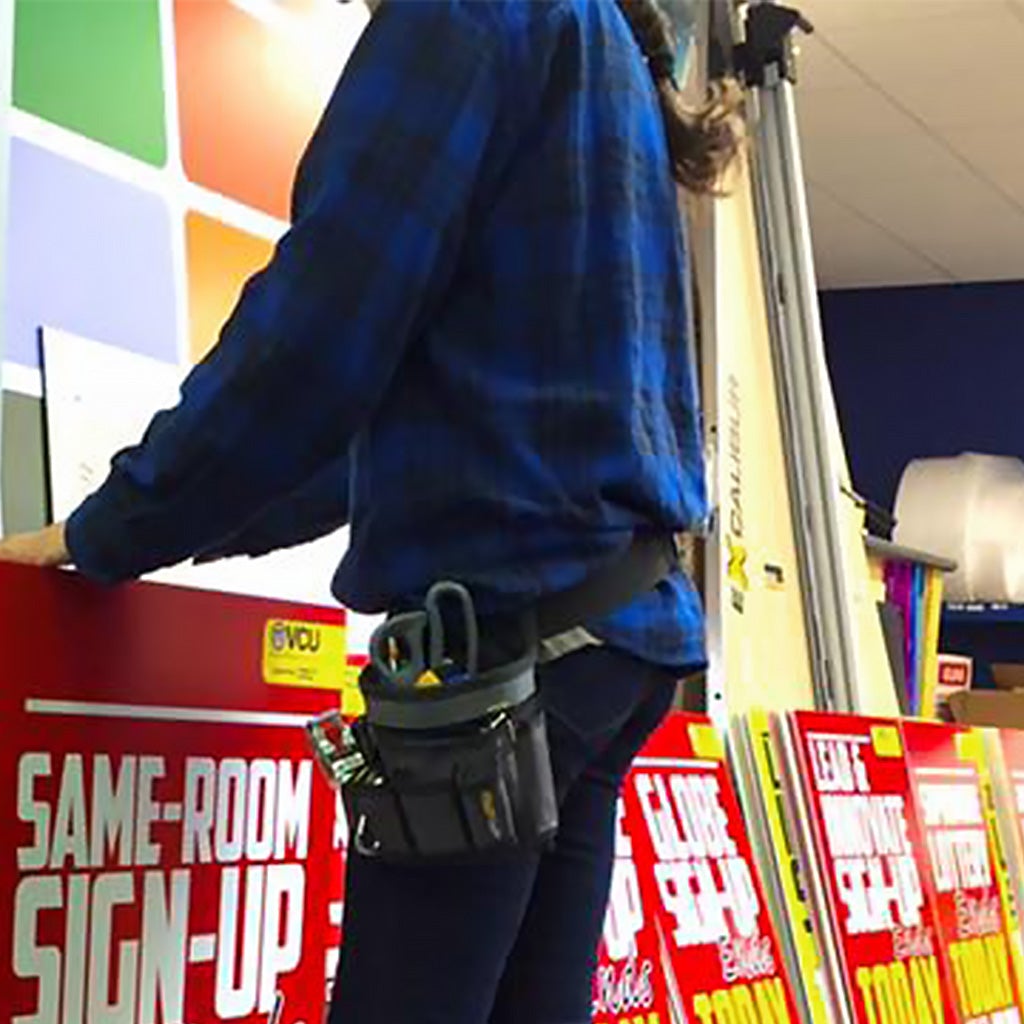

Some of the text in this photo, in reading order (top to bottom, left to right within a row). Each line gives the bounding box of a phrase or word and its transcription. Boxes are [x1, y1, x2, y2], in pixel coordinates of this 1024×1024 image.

[286, 625, 321, 652] VCU
[17, 752, 313, 870] SAME-ROOM
[634, 773, 738, 861] GLOBE
